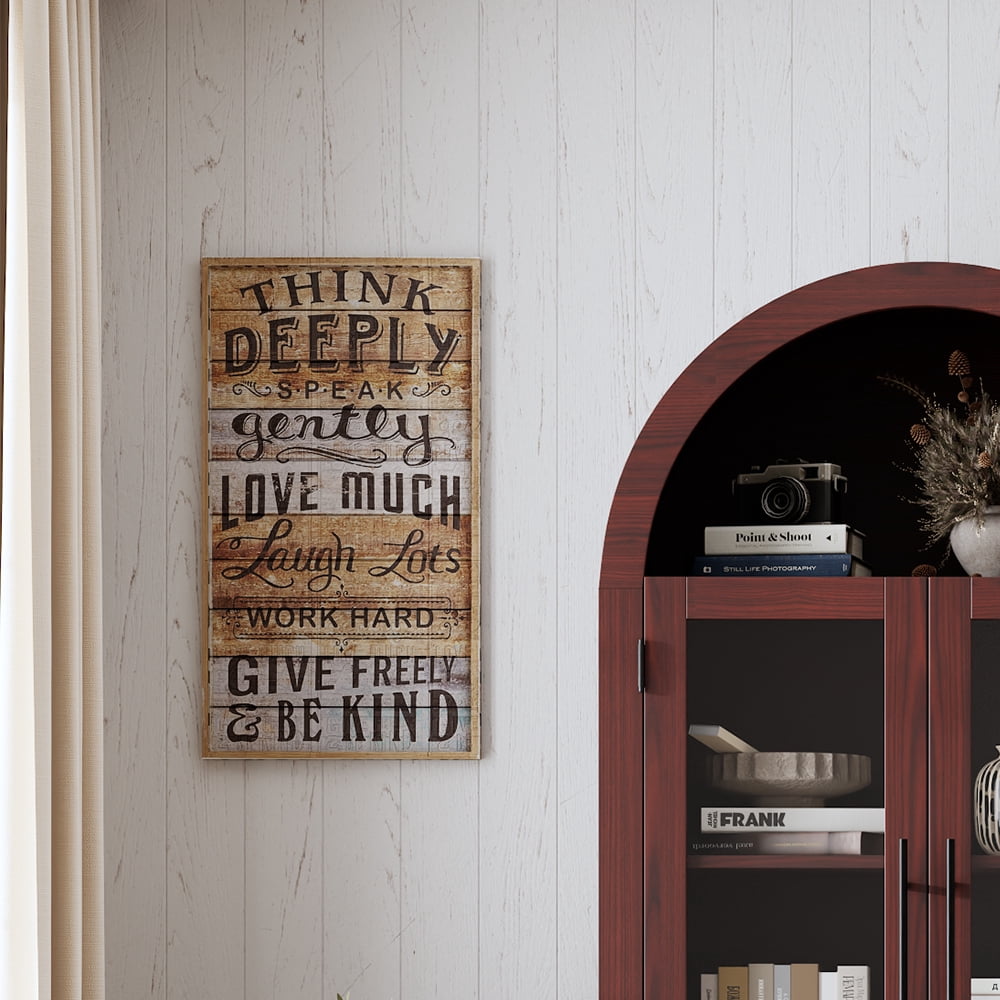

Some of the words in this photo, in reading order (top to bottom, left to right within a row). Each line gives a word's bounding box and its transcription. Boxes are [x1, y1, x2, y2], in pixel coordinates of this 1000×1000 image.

[240, 270, 443, 316] THINK
[224, 313, 462, 376] DEEPLY
[231, 403, 456, 467] gently
[221, 471, 319, 531] LOVE
[216, 518, 356, 593] Laugh
[368, 529, 461, 584] Lots
[735, 532, 766, 543] Point
[768, 533, 778, 543] &
[779, 531, 812, 542] Shoot
[247, 606, 338, 629] WORK
[351, 606, 434, 629] HARD
[227, 655, 335, 697] GIVE
[352, 655, 459, 689] FREELY
[226, 703, 262, 743] &
[277, 697, 323, 743] BE
[341, 689, 460, 743] KIND
[720, 812, 786, 828] FRANK
